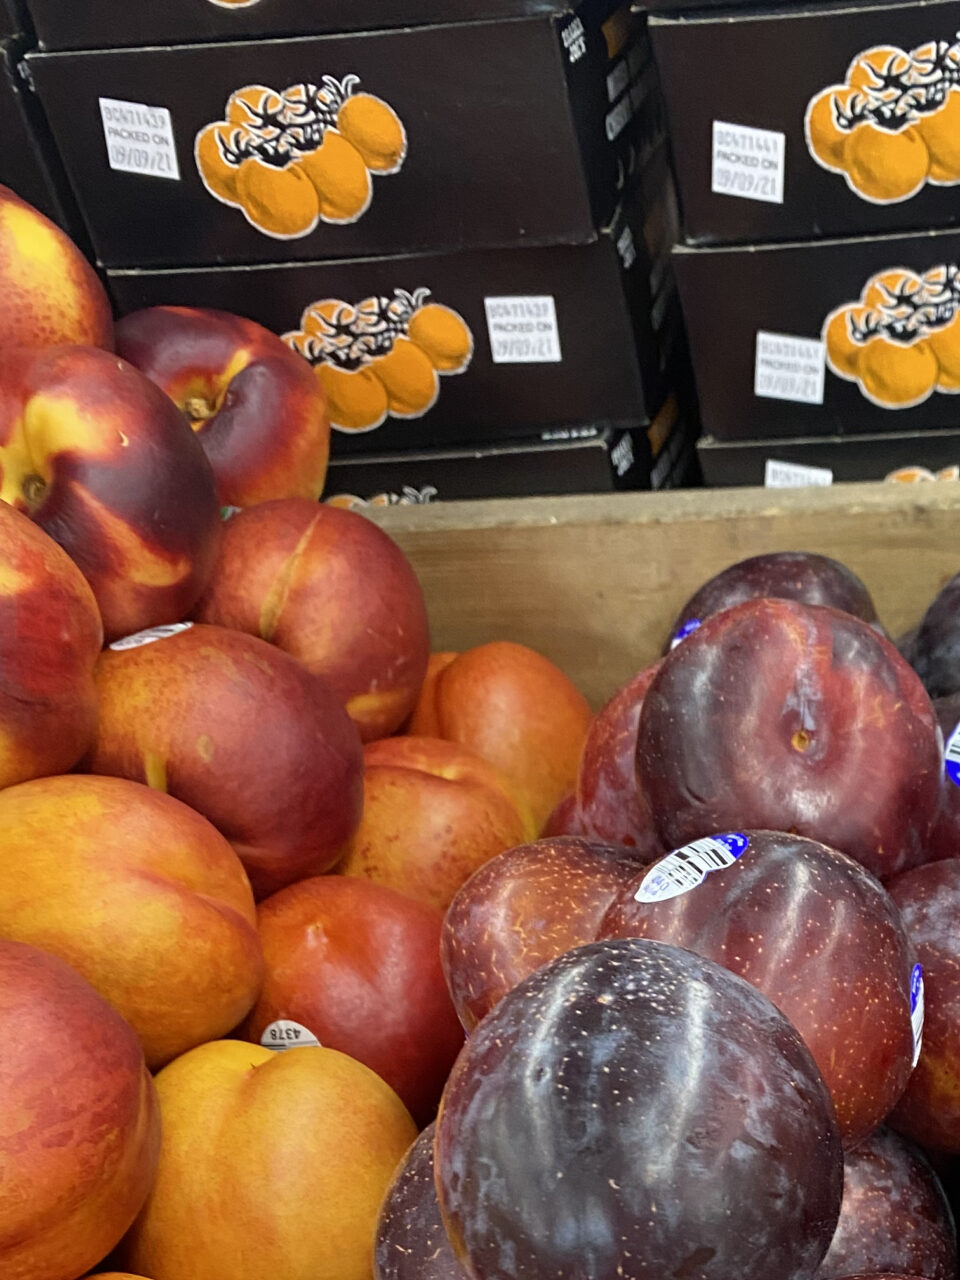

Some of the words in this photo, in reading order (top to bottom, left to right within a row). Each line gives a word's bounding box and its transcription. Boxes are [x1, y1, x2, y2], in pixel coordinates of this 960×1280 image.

[107, 126, 151, 143] PACKED
[152, 134, 170, 147] ON
[717, 149, 760, 168] PACKED
[761, 159, 779, 170] ON
[493, 322, 534, 333] PACKED
[536, 321, 552, 332] ON
[270, 1028, 301, 1040] 4378
